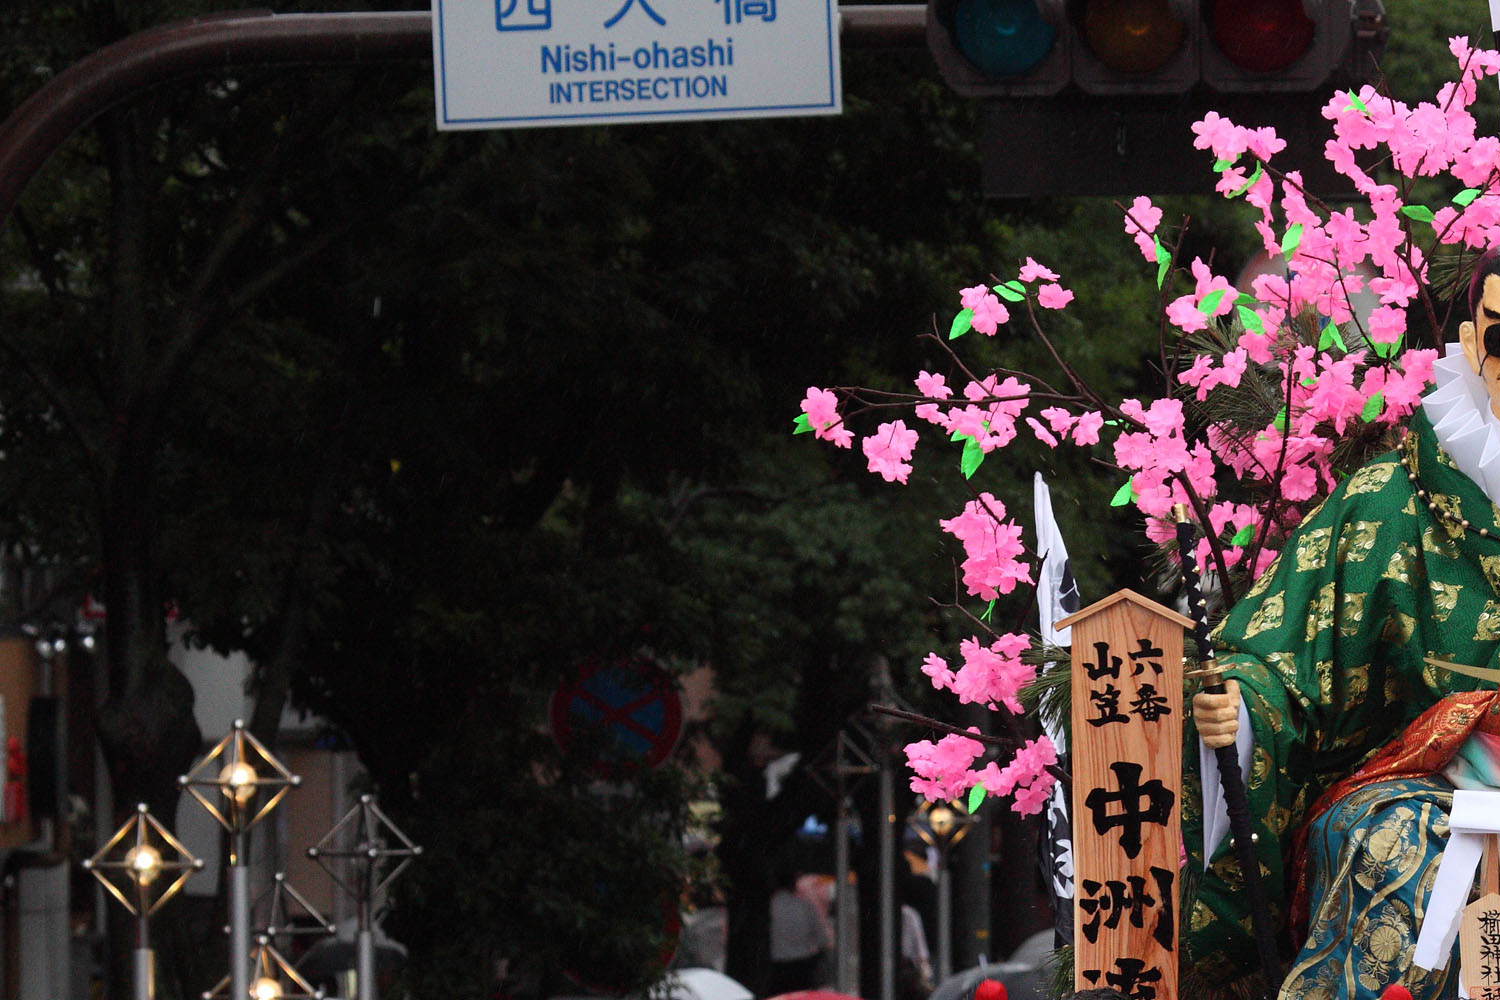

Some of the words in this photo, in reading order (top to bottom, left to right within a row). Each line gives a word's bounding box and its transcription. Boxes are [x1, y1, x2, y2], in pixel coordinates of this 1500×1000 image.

[541, 38, 734, 73] Nishi-ohashi
[549, 75, 727, 104] INTERSECTION
[1083, 641, 1130, 728] 山笠
[1128, 638, 1172, 723] 六番
